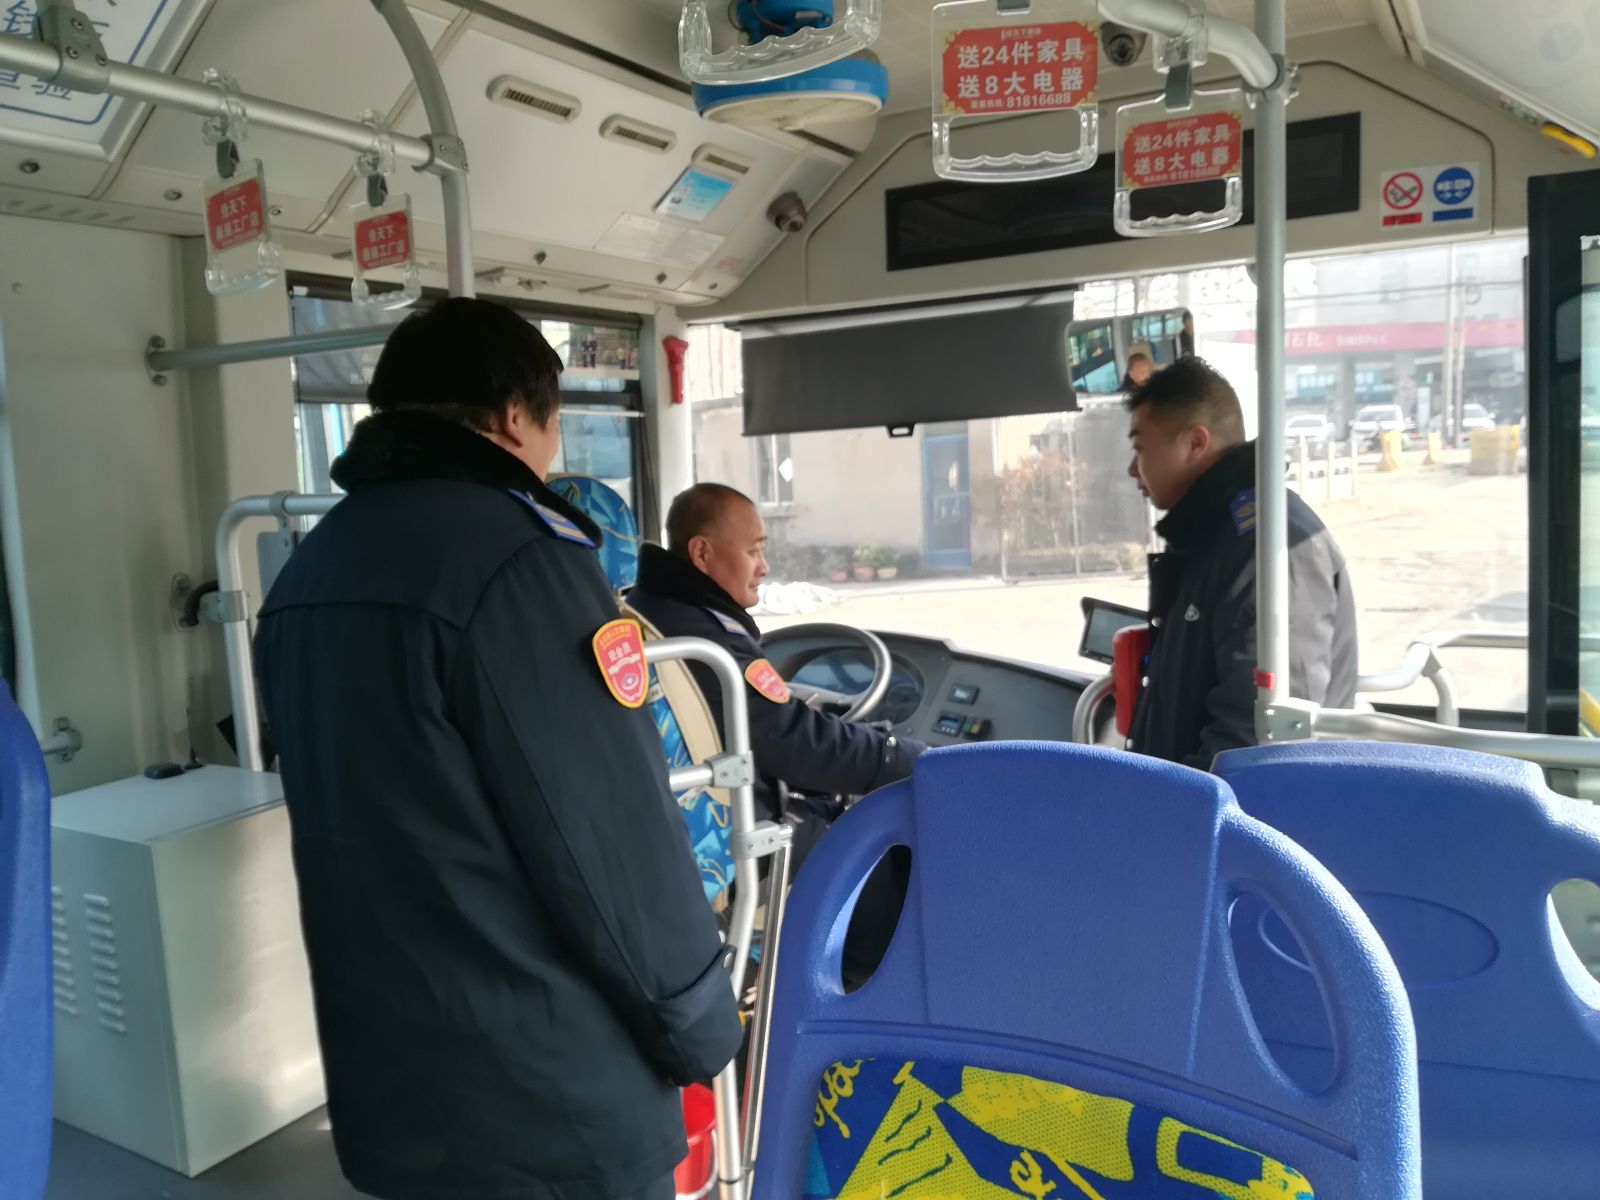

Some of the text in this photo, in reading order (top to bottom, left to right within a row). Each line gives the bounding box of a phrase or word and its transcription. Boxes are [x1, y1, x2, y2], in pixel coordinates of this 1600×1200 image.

[958, 37, 1085, 69] 送24件家具
[958, 66, 1083, 98] 送8大电器
[1134, 123, 1231, 154] 送24件家具
[1134, 146, 1230, 176] 送8大电器
